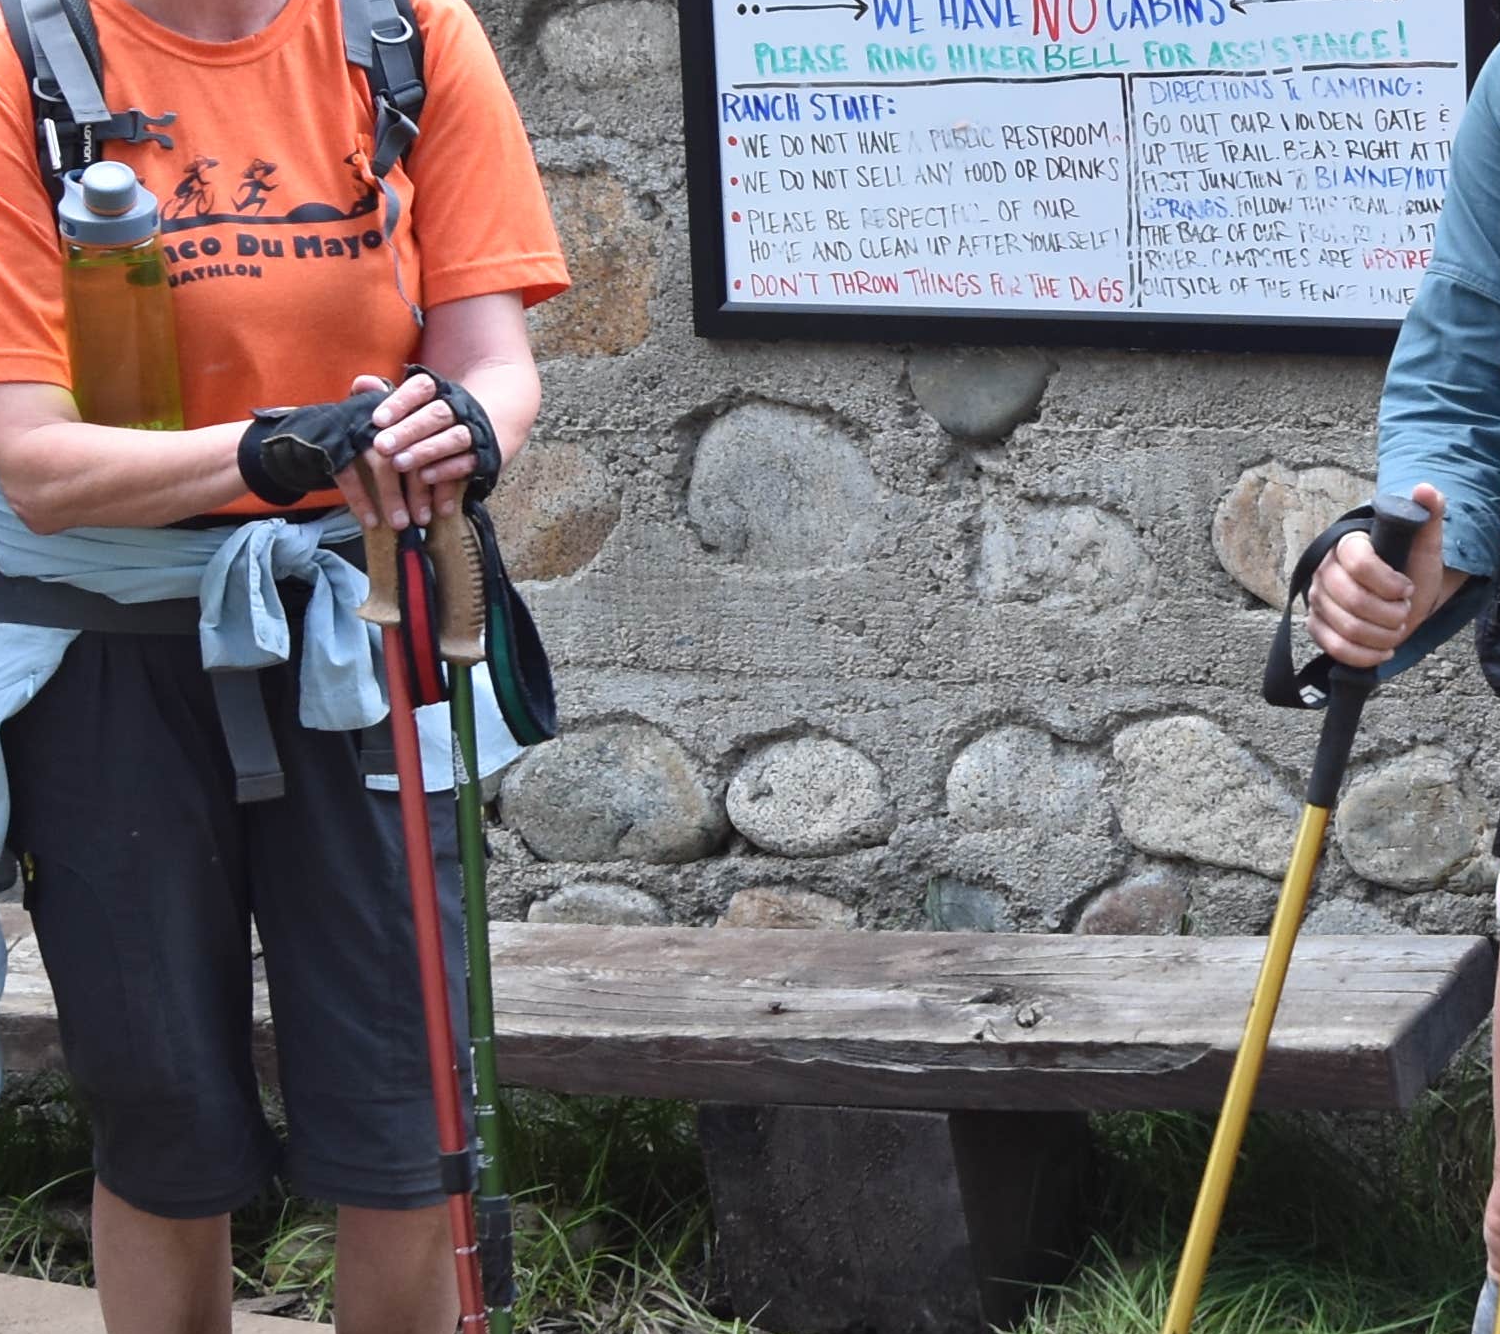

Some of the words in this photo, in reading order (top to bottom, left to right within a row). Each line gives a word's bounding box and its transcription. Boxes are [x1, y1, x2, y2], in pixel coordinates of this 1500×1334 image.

[754, 43, 848, 76] PLEASE
[867, 43, 936, 74] RING
[947, 43, 1040, 73] HIKER
[1044, 42, 1130, 73] BELL
[1144, 41, 1195, 67] FOR
[1149, 78, 1274, 105] DIRECTIONS
[1312, 76, 1423, 100] CAMPING:
[722, 92, 801, 122] RANCH
[810, 92, 896, 123] STUFF:
[1143, 111, 1171, 137] GO
[1180, 112, 1222, 137] OUT
[1231, 111, 1275, 134] OUR
[1374, 108, 1427, 132] GATE
[741, 133, 771, 158] WE
[781, 134, 804, 157] DO
[811, 132, 849, 155] NOT
[857, 130, 901, 155] HAVE
[1142, 142, 1166, 166] UP
[1170, 140, 1209, 164] THE
[1345, 139, 1400, 161] RIGHT
[1411, 141, 1430, 162] AT
[741, 171, 771, 194] WE
[780, 169, 804, 191] DO
[812, 168, 849, 190] NOT
[856, 165, 907, 188] SELL
[915, 160, 953, 186] ANY
[965, 161, 1007, 183] FOOD
[1015, 159, 1039, 181] OR
[1045, 156, 1119, 182] DRINKS
[748, 210, 816, 235] PLEASE
[825, 210, 850, 230] BE
[998, 200, 1021, 222] OF
[1033, 198, 1080, 220] OUR
[1236, 194, 1293, 218] FOLLOW
[1342, 194, 1394, 216] TRAIL
[163, 234, 221, 264] nco
[236, 233, 284, 258] Du
[291, 229, 383, 260] Mayo
[812, 240, 852, 262] AND
[860, 236, 918, 259] CLEAN
[927, 235, 951, 257] UP
[958, 233, 1022, 257] AFTER
[1140, 223, 1173, 247] THE
[1176, 221, 1223, 244] BACK
[1228, 222, 1249, 243] OF
[1252, 220, 1293, 242] OUR
[1318, 248, 1356, 268] ARE
[167, 263, 262, 289] UATHLON
[751, 271, 819, 297] DON'T
[829, 270, 899, 296] THROW
[903, 267, 982, 298] THINGS
[1027, 273, 1060, 299] THE
[1142, 276, 1221, 300] OUTSIDE
[1229, 276, 1249, 295] OF
[1255, 277, 1291, 299] THE
